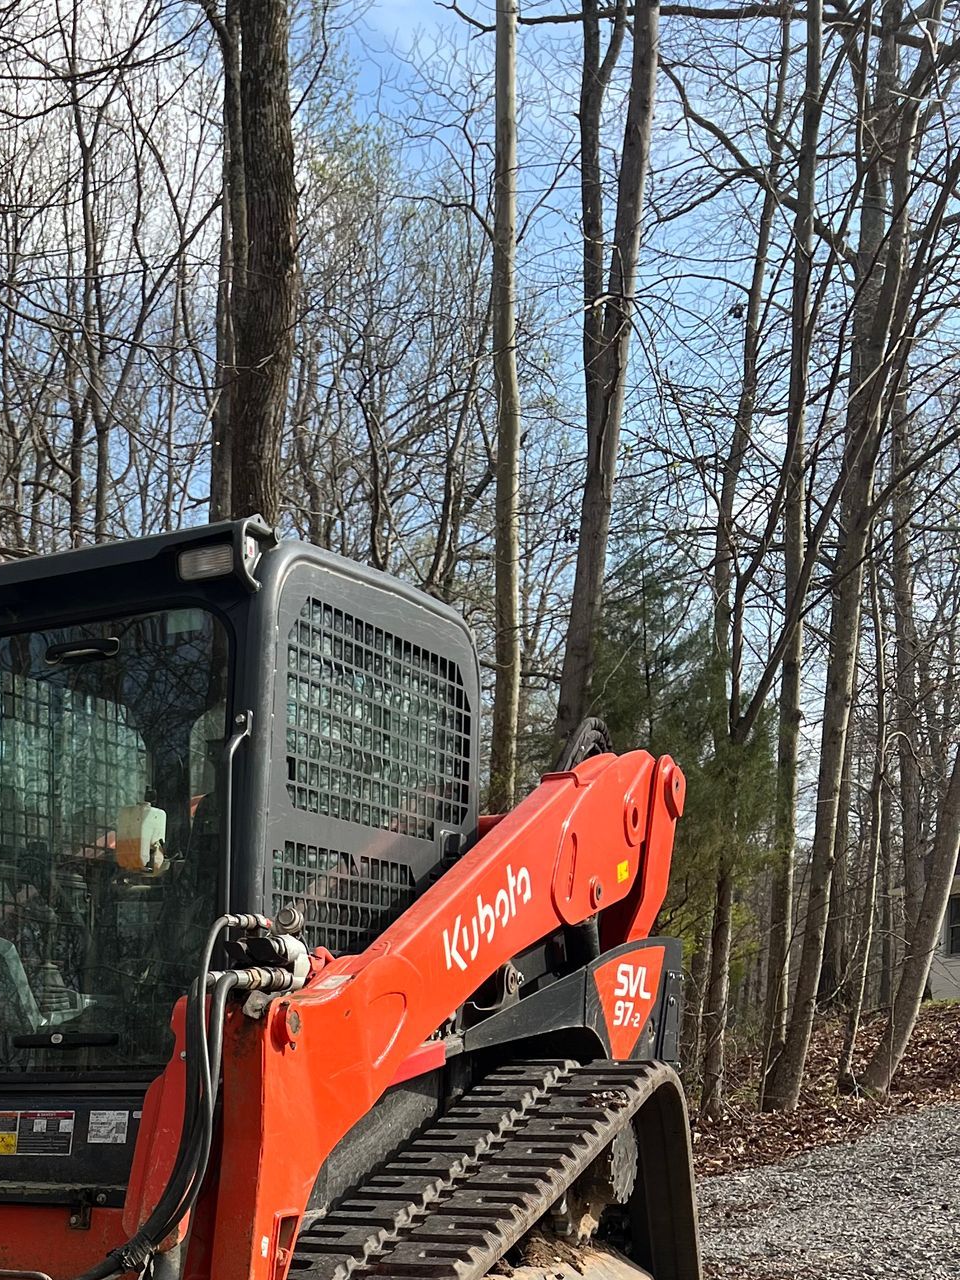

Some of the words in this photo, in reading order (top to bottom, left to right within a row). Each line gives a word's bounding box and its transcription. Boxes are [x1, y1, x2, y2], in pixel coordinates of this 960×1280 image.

[442, 864, 532, 970] Kubota
[613, 963, 651, 1000] SVL
[613, 1001, 640, 1028] 97-2
